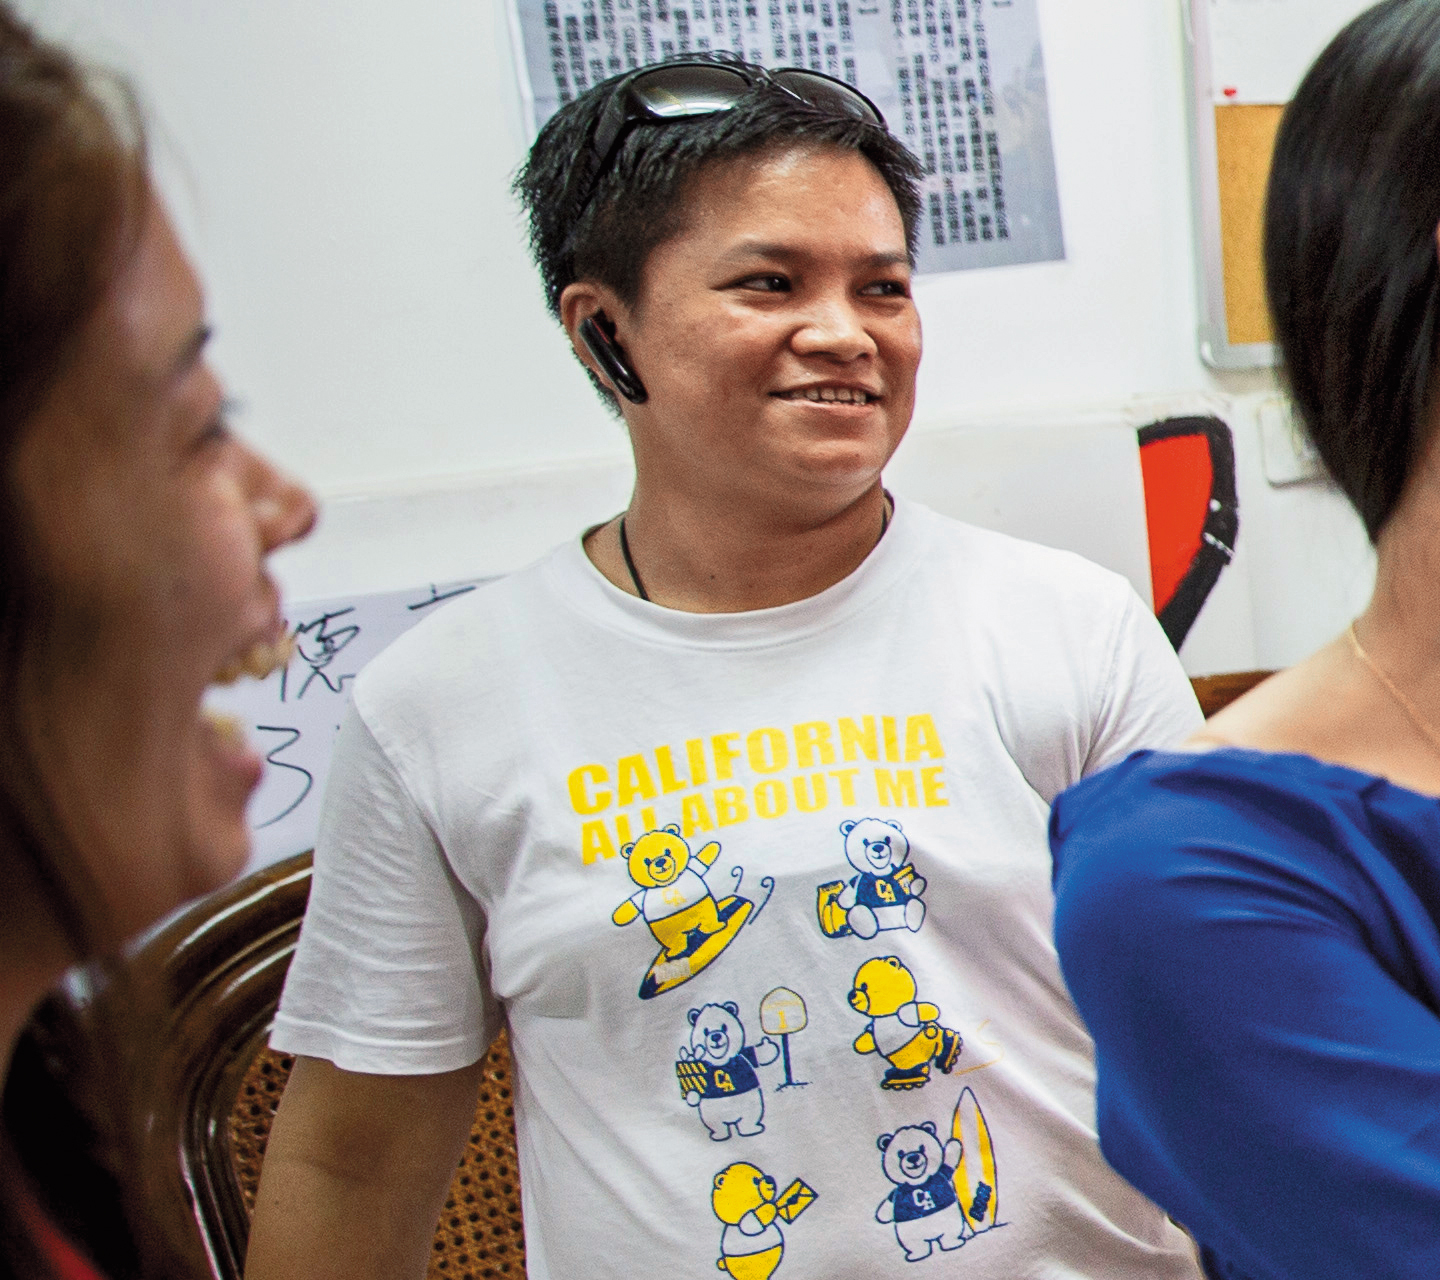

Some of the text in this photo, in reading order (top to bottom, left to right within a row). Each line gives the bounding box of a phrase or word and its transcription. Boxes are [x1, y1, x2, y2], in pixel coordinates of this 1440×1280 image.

[567, 713, 946, 816] CALIFORNIA
[680, 768, 861, 840] ABOUT
[876, 766, 951, 810] ME
